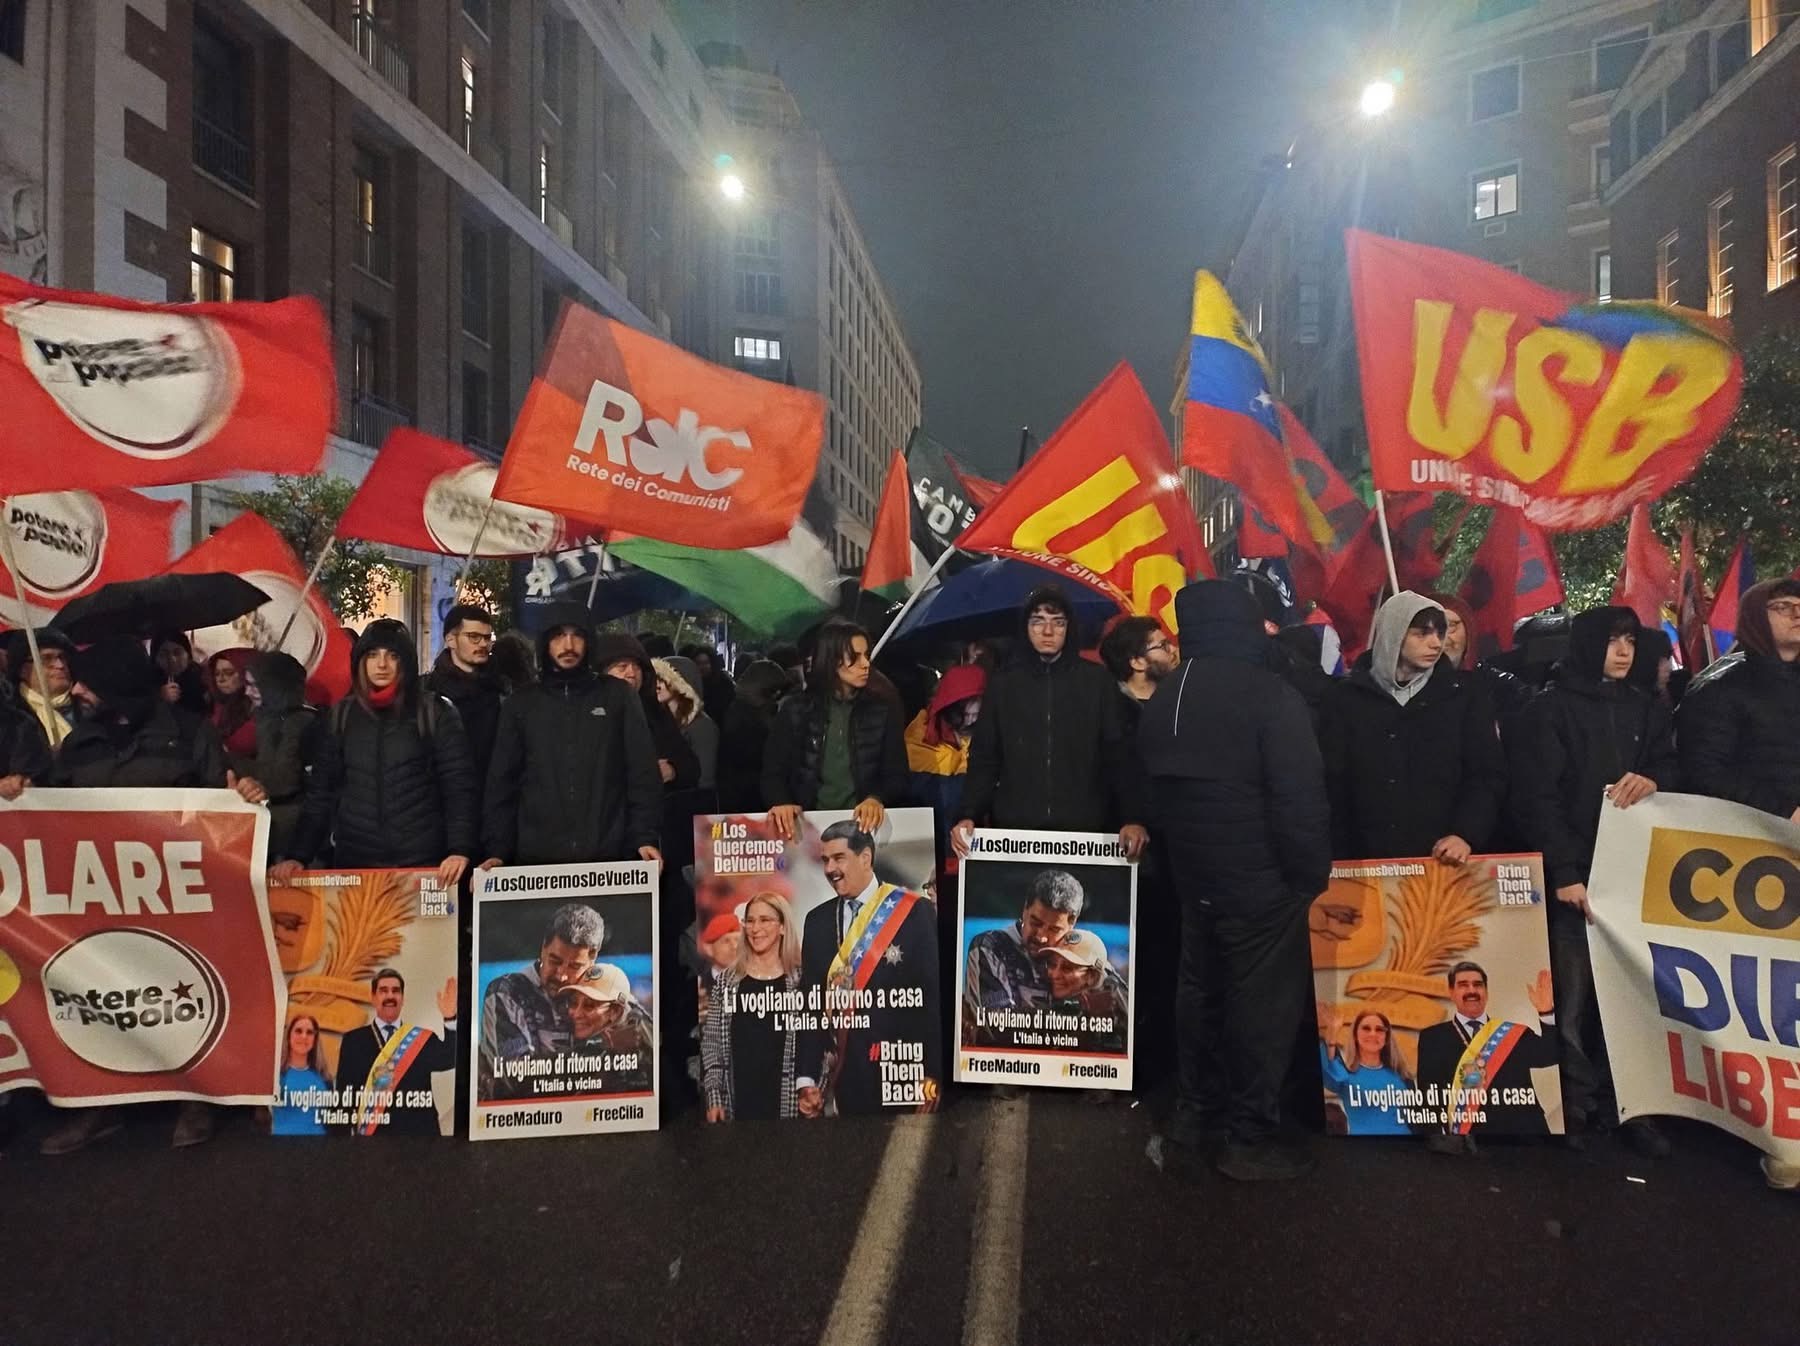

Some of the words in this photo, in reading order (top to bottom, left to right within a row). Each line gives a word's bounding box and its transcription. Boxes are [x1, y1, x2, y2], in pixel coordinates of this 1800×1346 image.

[1407, 299, 1730, 495] USB
[566, 455, 609, 481] Rete
[611, 471, 642, 492] dei
[644, 483, 732, 512] Comunisti
[919, 477, 976, 522] CAMB
[711, 822, 747, 839] #Los
[713, 839, 784, 856] Queremos
[714, 855, 774, 873] DeVuelta
[484, 869, 649, 893] #LosQueremosDeVuelta
[1497, 879, 1531, 891] Them
[420, 890, 447, 903] Them
[1499, 892, 1532, 905] Back
[420, 902, 448, 916] Back
[724, 987, 737, 1013] Li
[741, 986, 804, 1019] vogliamo
[808, 984, 821, 1010] di
[825, 984, 872, 1010] ritorno
[877, 990, 886, 1008] a
[890, 987, 923, 1008] casa
[774, 1013, 818, 1031] L'Italia
[821, 1013, 829, 1029] è
[832, 1013, 870, 1029] vicina
[977, 1008, 985, 1026] Li
[988, 1010, 1030, 1032] vogliamo
[1034, 1010, 1043, 1029] di
[1045, 1011, 1077, 1031] ritorno
[1081, 1016, 1087, 1031] a
[1089, 1016, 1113, 1032] casa
[1013, 1032, 1043, 1045] L'Italia
[1045, 1033, 1050, 1045] è
[1053, 1034, 1078, 1046] vicina
[869, 1040, 923, 1061] #Bring
[494, 1057, 504, 1079] Li
[506, 1054, 552, 1083] vogliamo
[554, 1053, 565, 1074] di
[567, 1052, 601, 1072] ritorno
[604, 1055, 611, 1071] a
[613, 1053, 638, 1071] casa
[880, 1062, 924, 1080] Them
[961, 1058, 1040, 1075] #FreeMaduro
[1062, 1063, 1118, 1079] #FreeCilia
[534, 1079, 564, 1093] L'Italia
[567, 1079, 572, 1091] è
[575, 1077, 602, 1089] vicina
[882, 1080, 925, 1101] Back
[1667, 1031, 1800, 1140] LIBE
[290, 1086, 339, 1112] vogliamo
[342, 1085, 352, 1107] di
[396, 1091, 402, 1107] a
[406, 1090, 432, 1107] casa
[1349, 1085, 1362, 1107] Li
[1365, 1085, 1423, 1112] vogliamo
[1427, 1084, 1439, 1106] di
[1491, 1087, 1499, 1105] a
[1503, 1087, 1536, 1105] casa
[314, 1110, 349, 1124] L'Italia
[351, 1109, 357, 1124] è
[361, 1110, 390, 1124] vicina
[478, 1110, 562, 1129] #FreeMaduro
[585, 1105, 644, 1122] #FreeCilia
[1397, 1109, 1437, 1124] L'Italia
[1440, 1108, 1448, 1124] è
[1452, 1109, 1487, 1123] vicina
